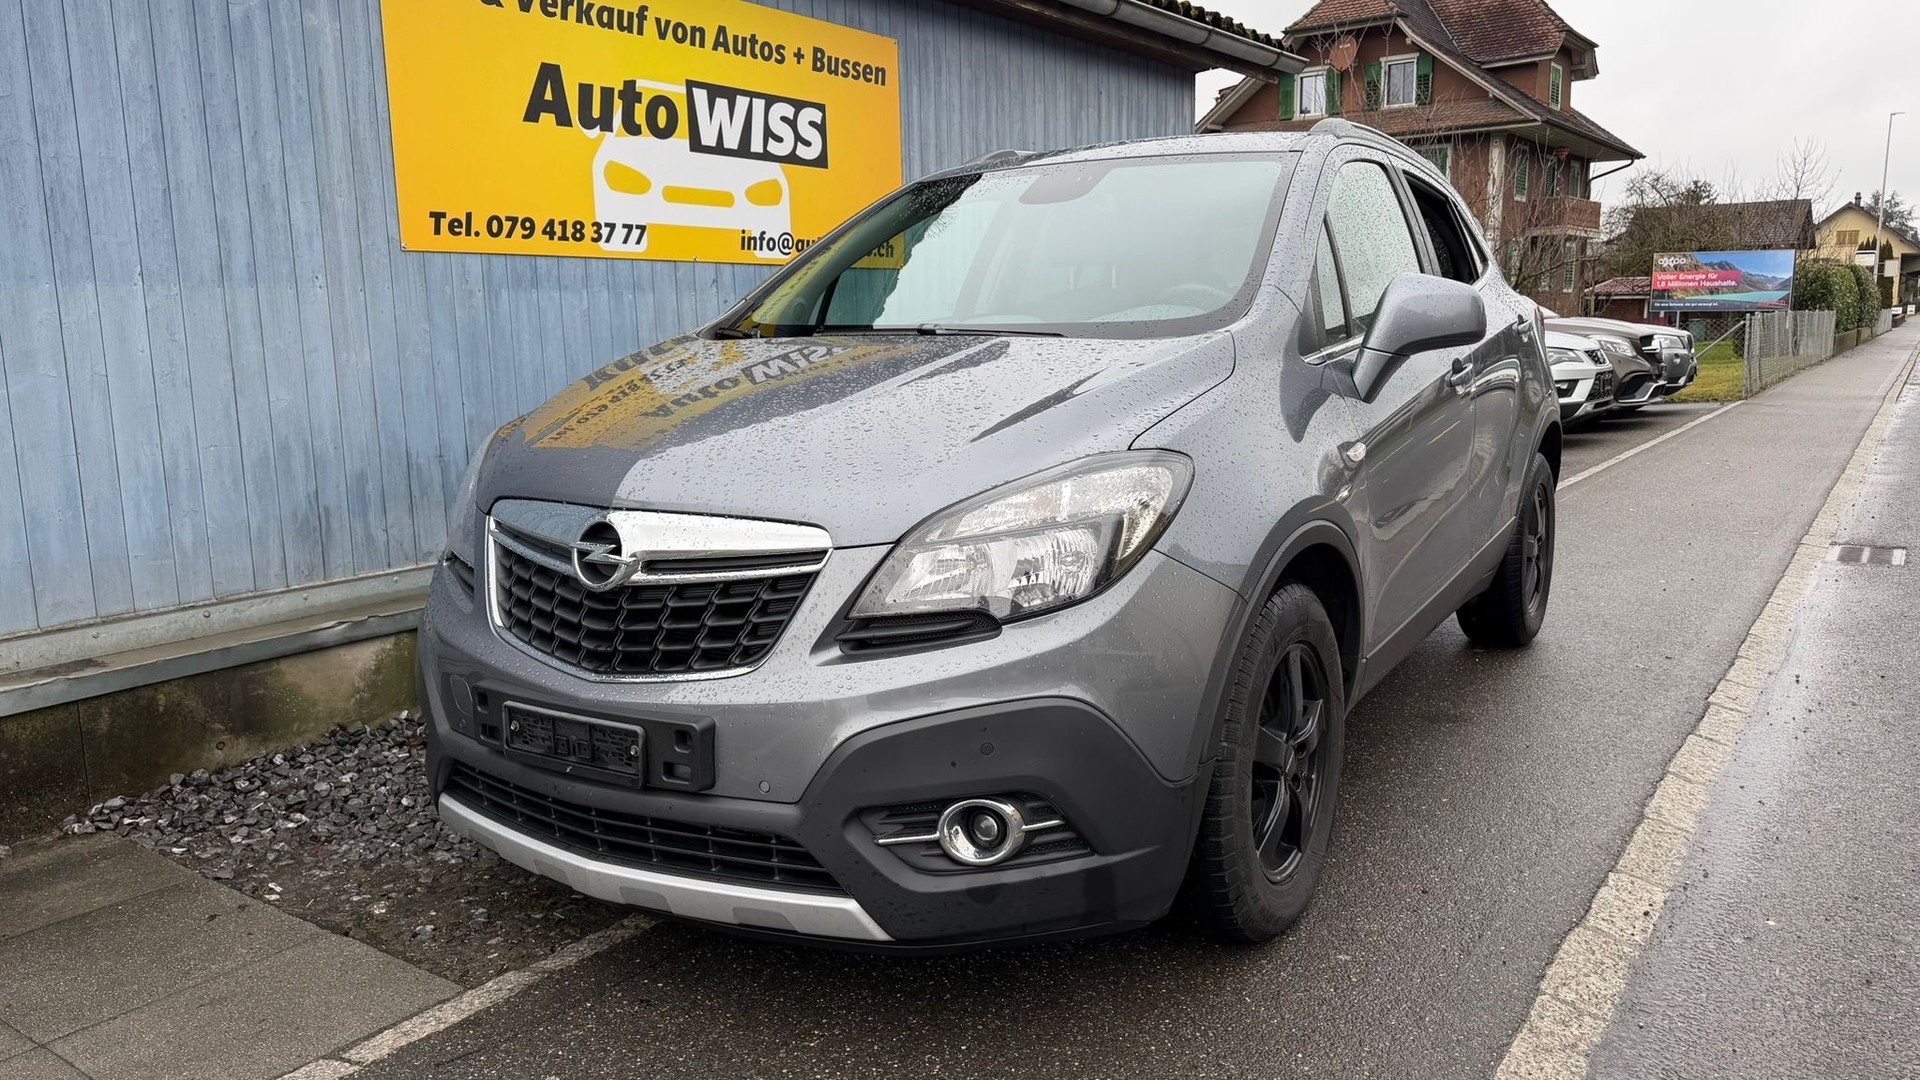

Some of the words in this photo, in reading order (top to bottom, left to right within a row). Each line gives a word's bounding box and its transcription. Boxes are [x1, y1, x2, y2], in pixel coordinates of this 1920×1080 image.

[654, 16, 706, 49] von
[711, 25, 787, 66] Autos
[793, 47, 805, 66] +
[812, 46, 886, 86] Bussen
[522, 62, 680, 140] Auto
[691, 87, 824, 161] WISS
[429, 211, 481, 239] Tel.
[486, 215, 536, 240] 079
[541, 218, 586, 243] 418
[590, 221, 617, 244] 37
[621, 223, 648, 245] 77
